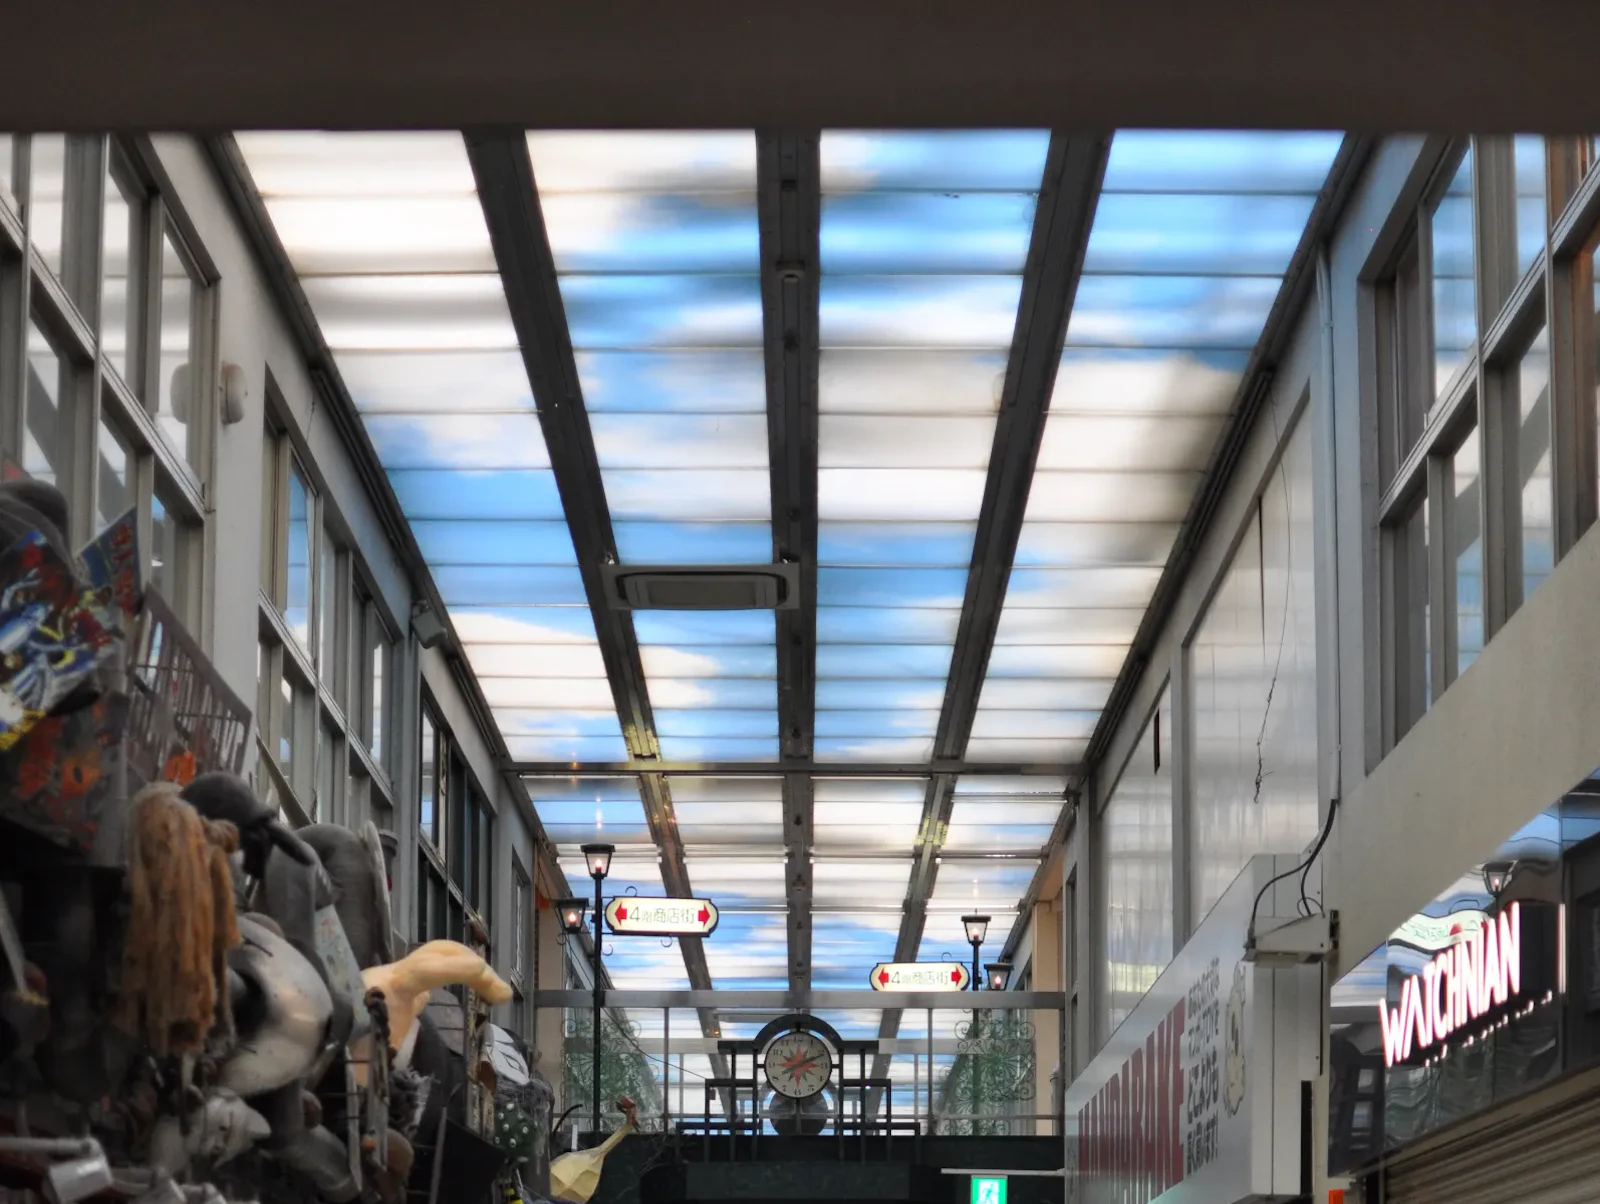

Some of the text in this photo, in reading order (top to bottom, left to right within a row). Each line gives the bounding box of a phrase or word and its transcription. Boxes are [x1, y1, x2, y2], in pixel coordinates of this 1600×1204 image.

[629, 906, 696, 924] 4階商店街
[1379, 901, 1520, 1068] WATCHNIAN
